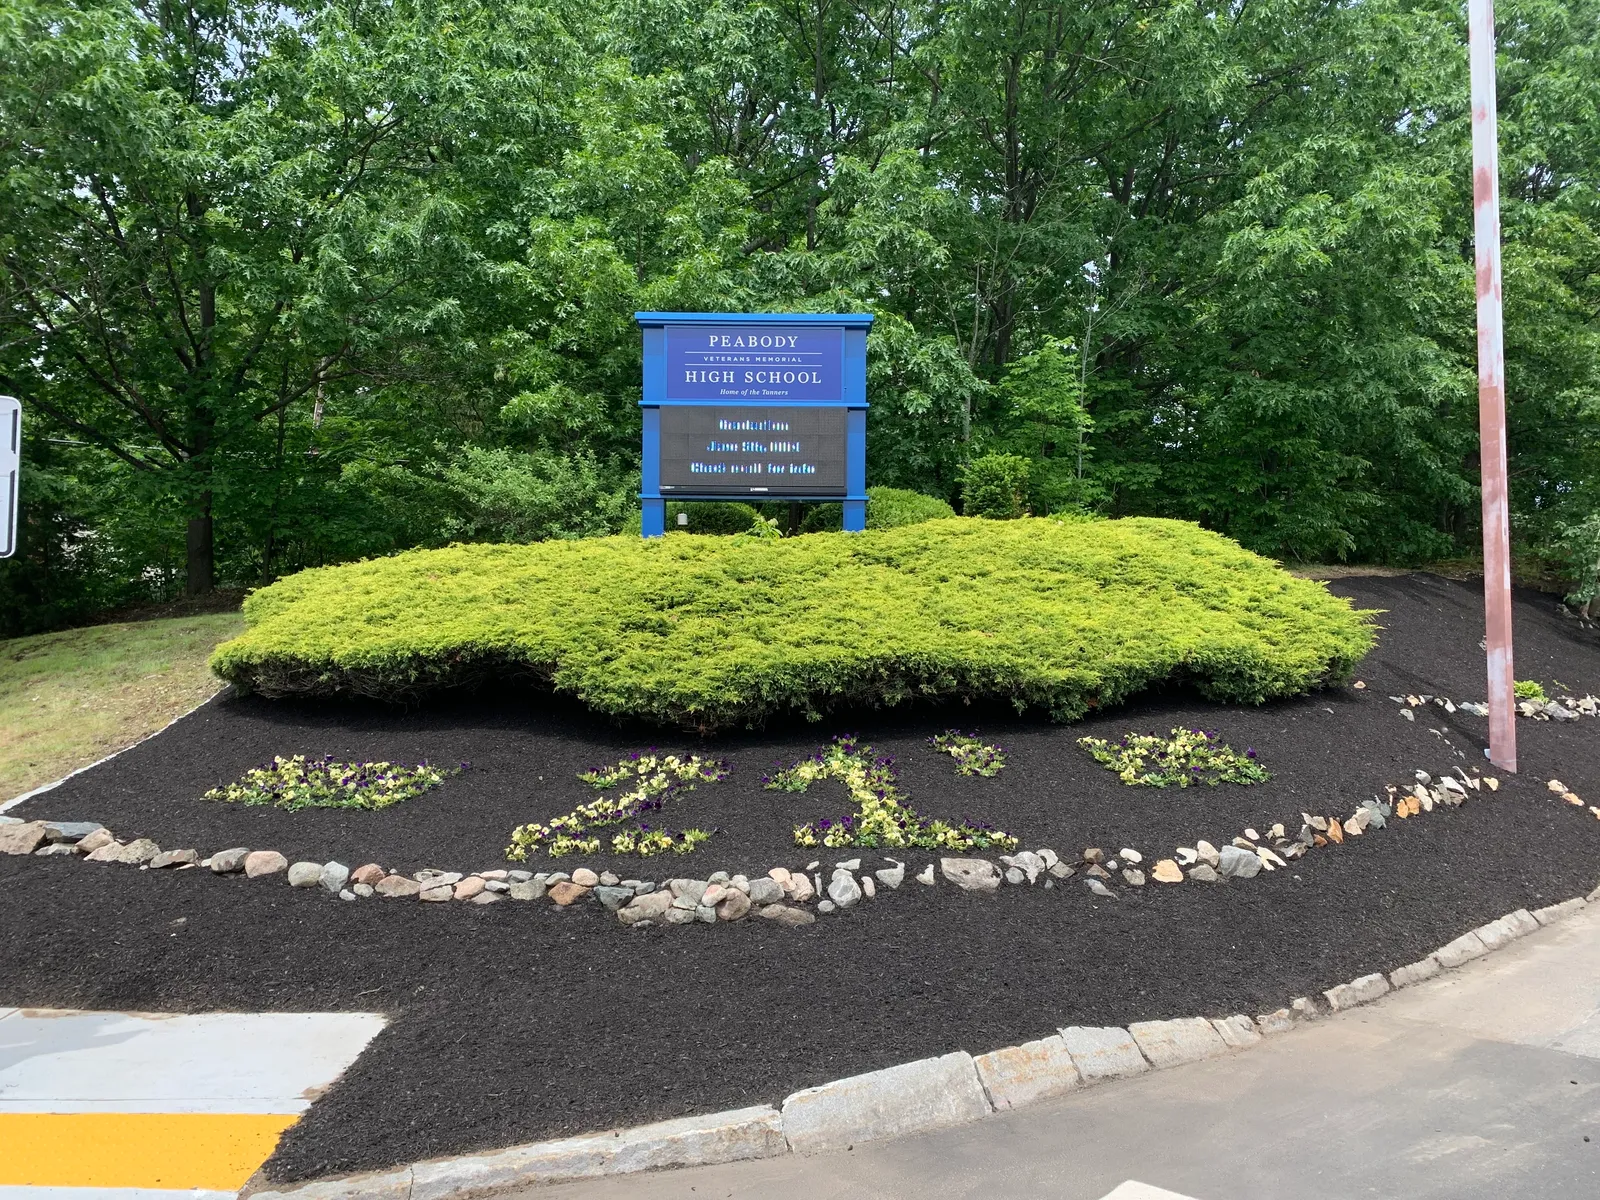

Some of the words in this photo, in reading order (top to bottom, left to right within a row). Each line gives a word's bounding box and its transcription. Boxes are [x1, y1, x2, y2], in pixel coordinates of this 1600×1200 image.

[708, 335, 799, 348] PEABODY
[685, 370, 735, 383] HIGH
[744, 371, 822, 384] SCHOOL
